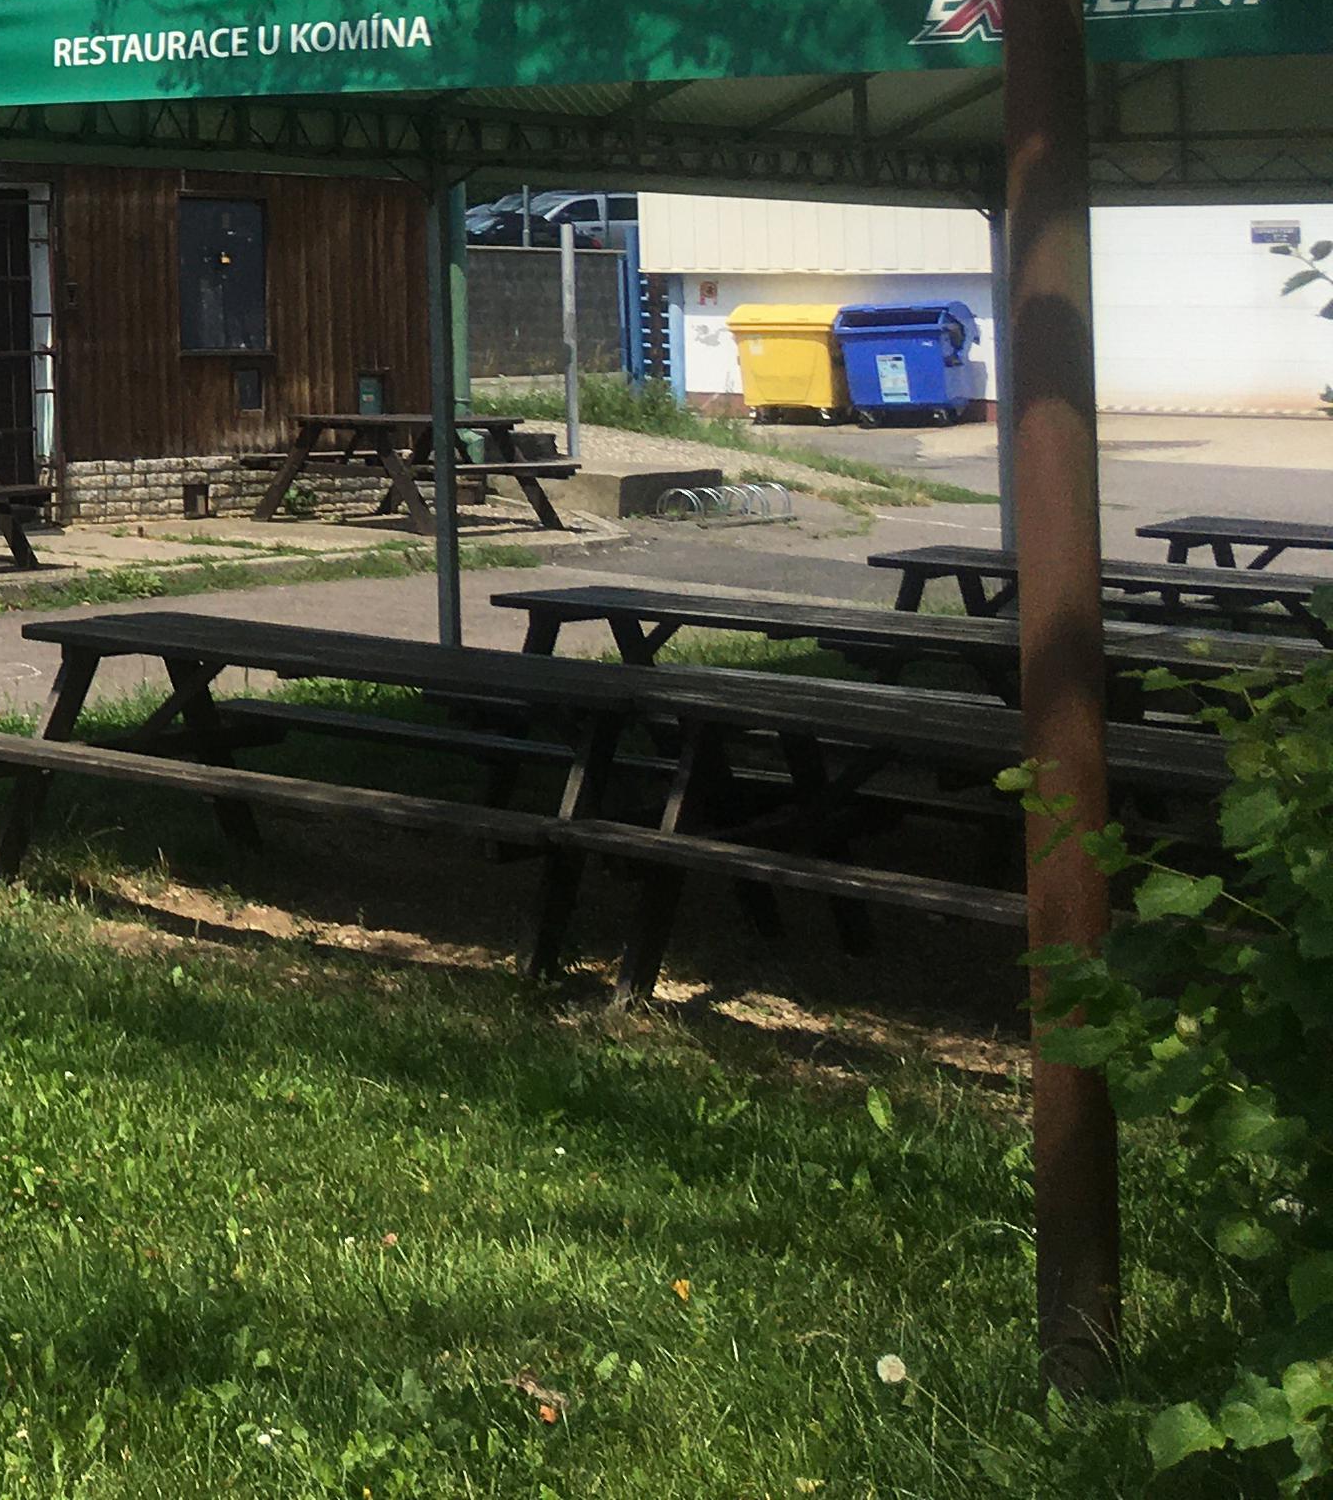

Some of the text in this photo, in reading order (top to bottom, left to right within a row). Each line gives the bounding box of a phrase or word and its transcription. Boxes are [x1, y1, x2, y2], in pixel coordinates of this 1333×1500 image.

[53, 13, 433, 67] RESTAURACE U KOMÍNA
